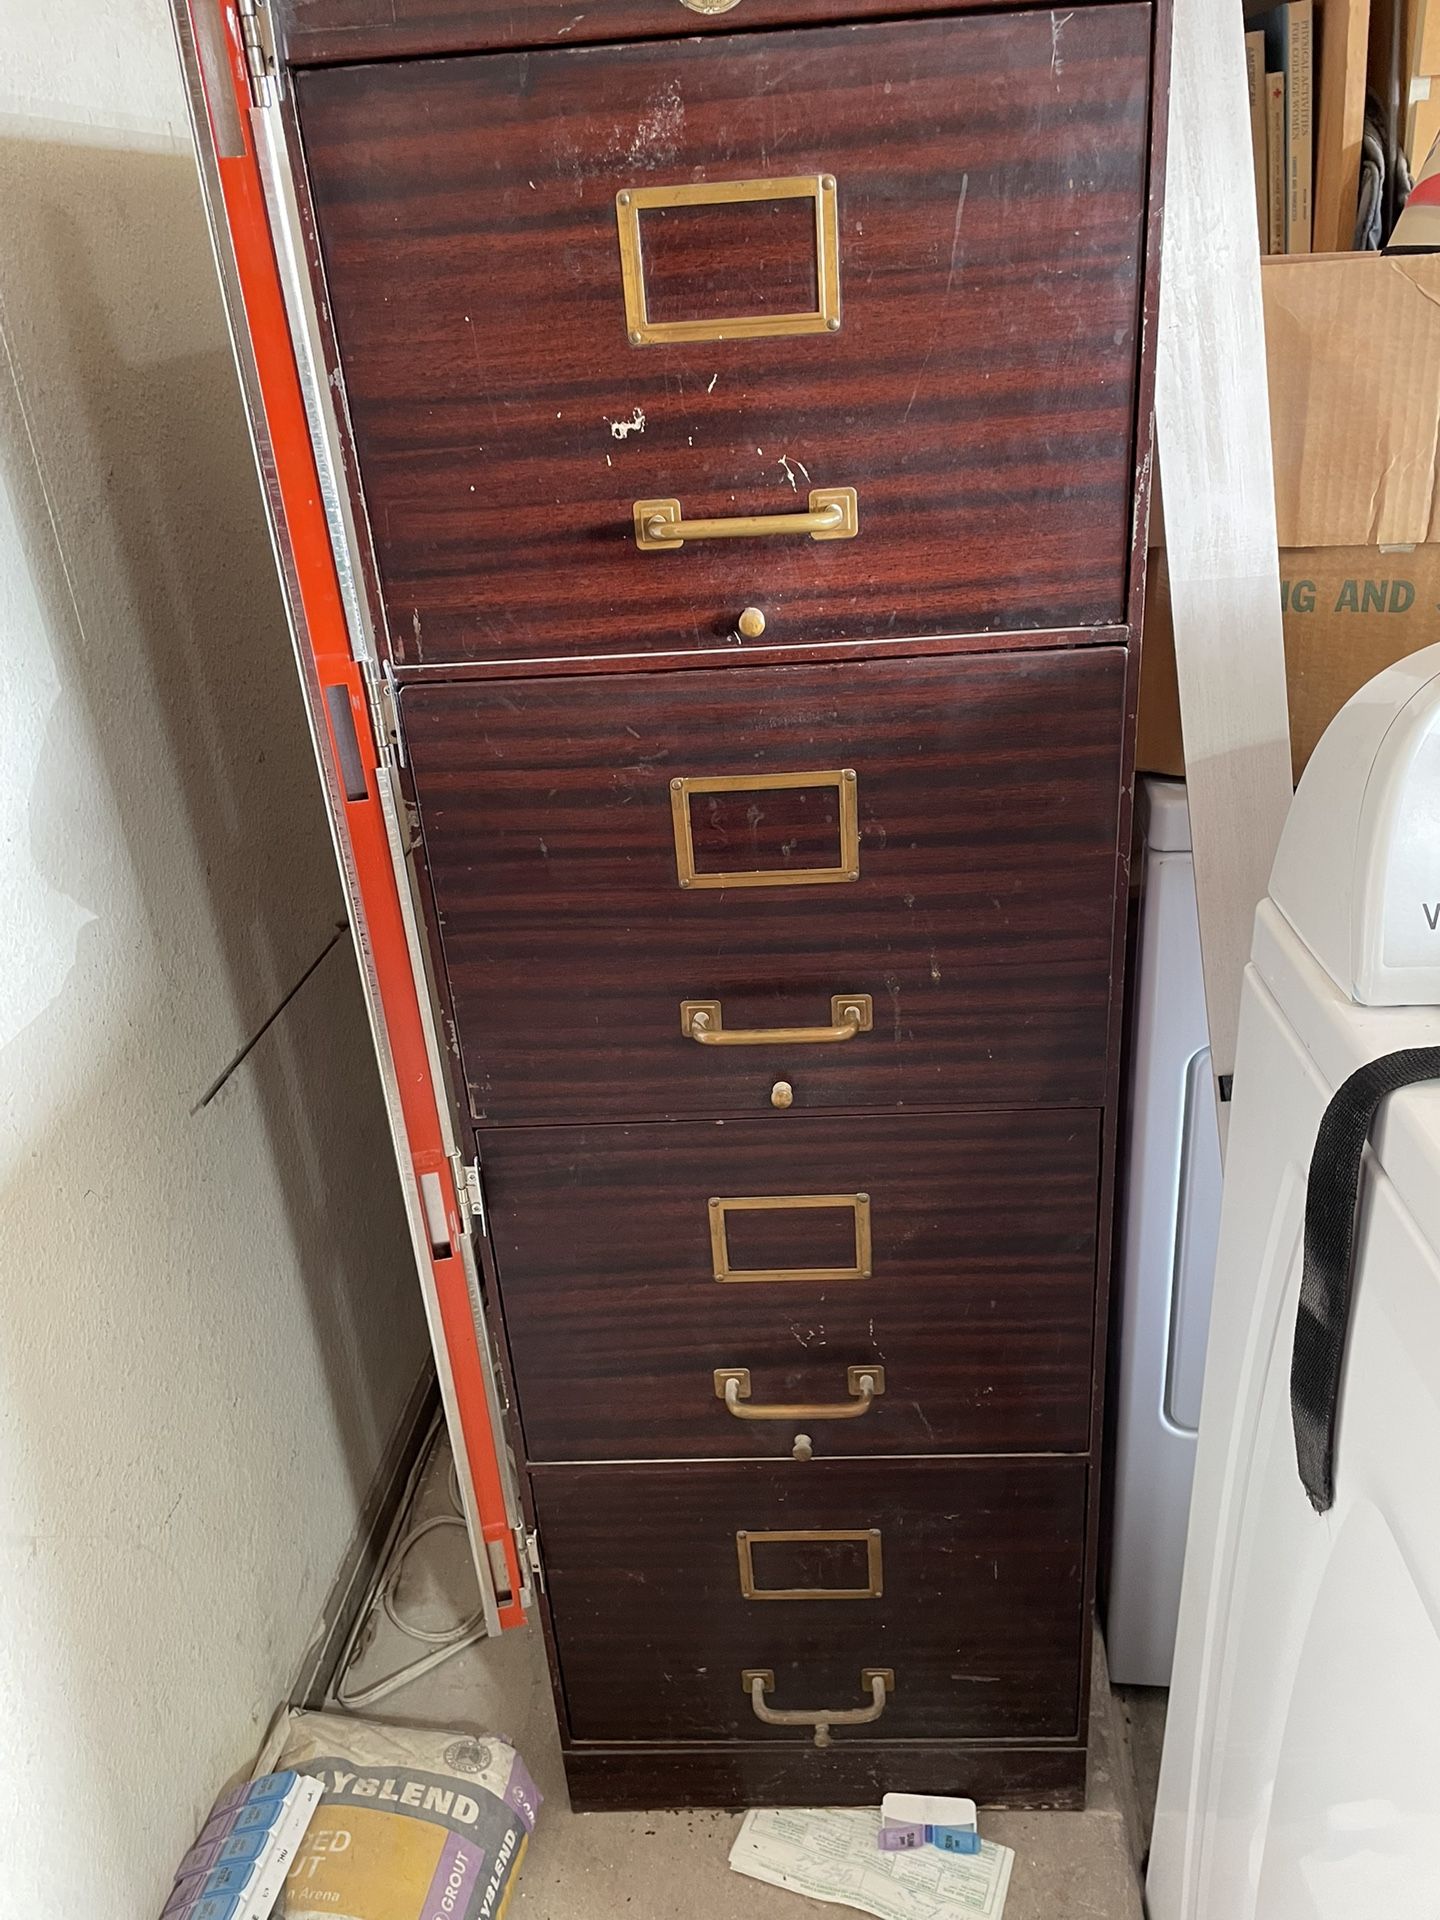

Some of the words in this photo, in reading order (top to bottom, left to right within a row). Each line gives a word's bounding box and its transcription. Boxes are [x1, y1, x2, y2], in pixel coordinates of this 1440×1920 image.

[1291, 22, 1300, 45] FOR
[1301, 20, 1310, 73] PHYSICAL
[1291, 47, 1300, 98] COLLEGE
[1291, 100, 1300, 141] WOMEN
[1301, 76, 1310, 136] ACTIVITIES
[1334, 580, 1415, 613] AND
[299, 1887, 340, 1902] Arena
[441, 1850, 469, 1912] GROUT
[478, 1828, 515, 1920] YBLEND
